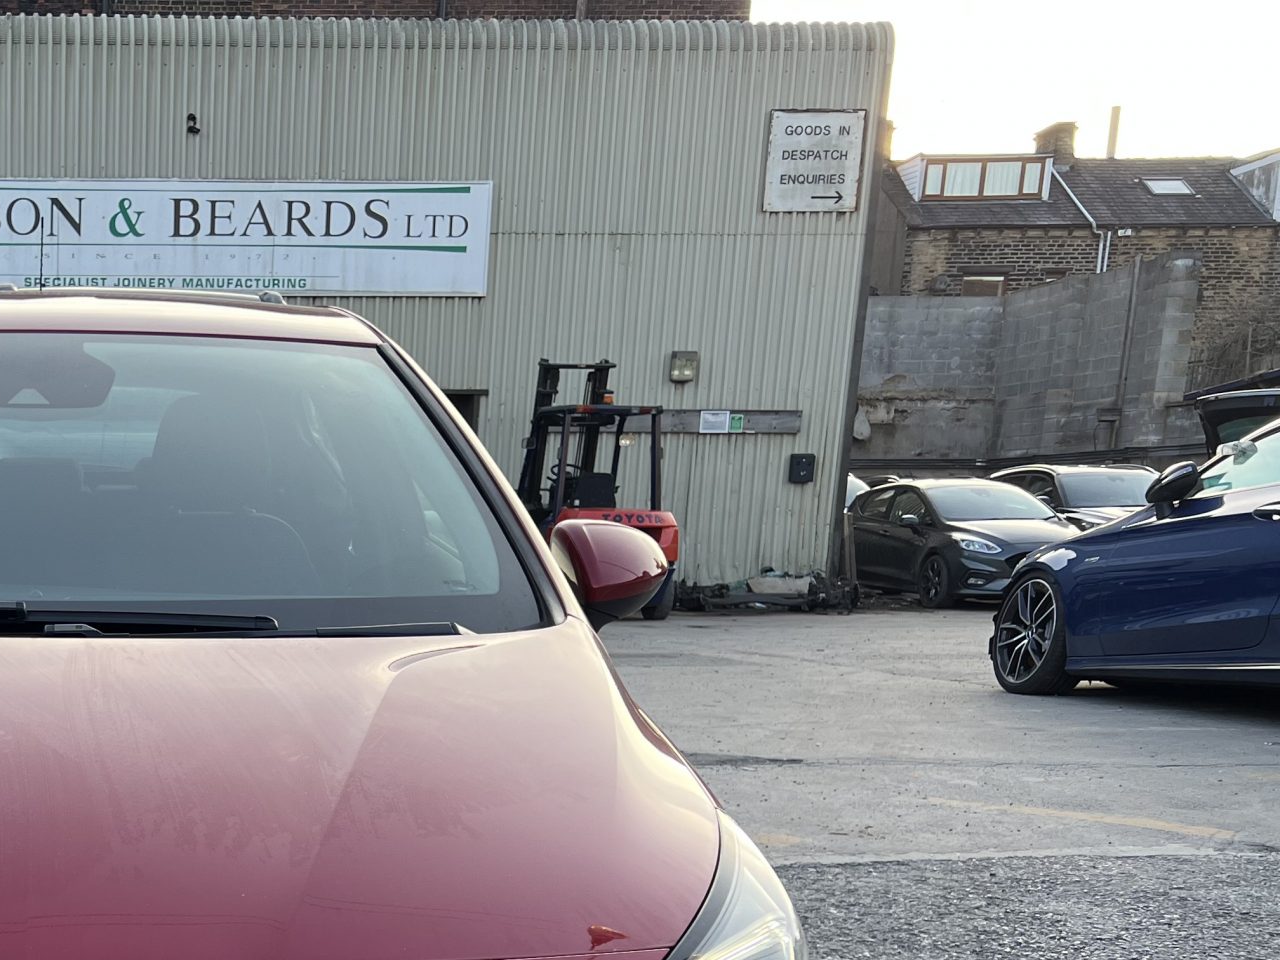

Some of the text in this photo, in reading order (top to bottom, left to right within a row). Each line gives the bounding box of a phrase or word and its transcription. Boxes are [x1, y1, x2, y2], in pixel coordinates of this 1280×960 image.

[784, 125, 850, 136] GOODS IN
[781, 149, 848, 161] DESPATCH
[780, 174, 846, 185] ENQUIRIES
[108, 197, 145, 238] &
[168, 197, 390, 239] BEARDS
[403, 214, 469, 238] LTD
[24, 277, 307, 289] SPECIALIST JOINERY MANUFACTURING
[602, 513, 663, 525] TOYOTA
